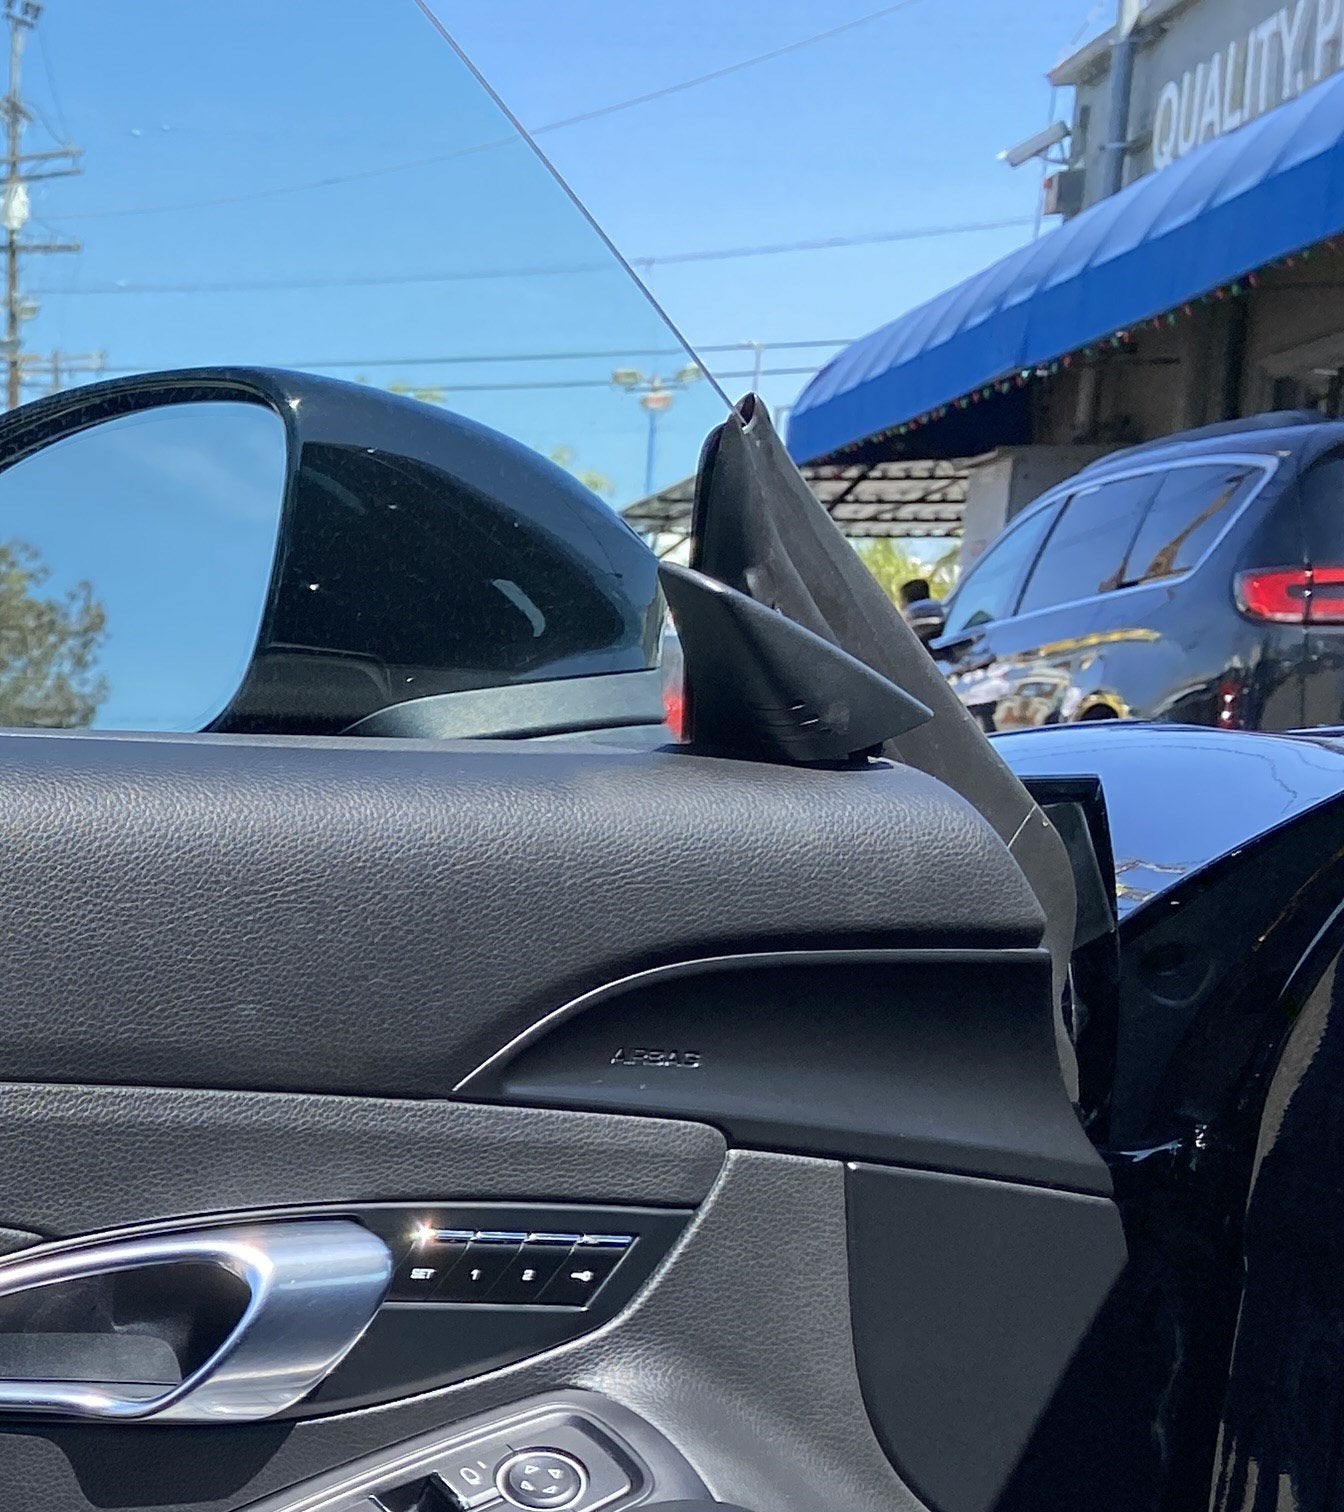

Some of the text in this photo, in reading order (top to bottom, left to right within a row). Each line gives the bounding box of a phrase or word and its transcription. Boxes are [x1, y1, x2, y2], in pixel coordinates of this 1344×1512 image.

[1153, 0, 1305, 170] QUALITY
[410, 1268, 437, 1279] SET
[470, 1269, 481, 1280] 1
[522, 1269, 535, 1281] 2
